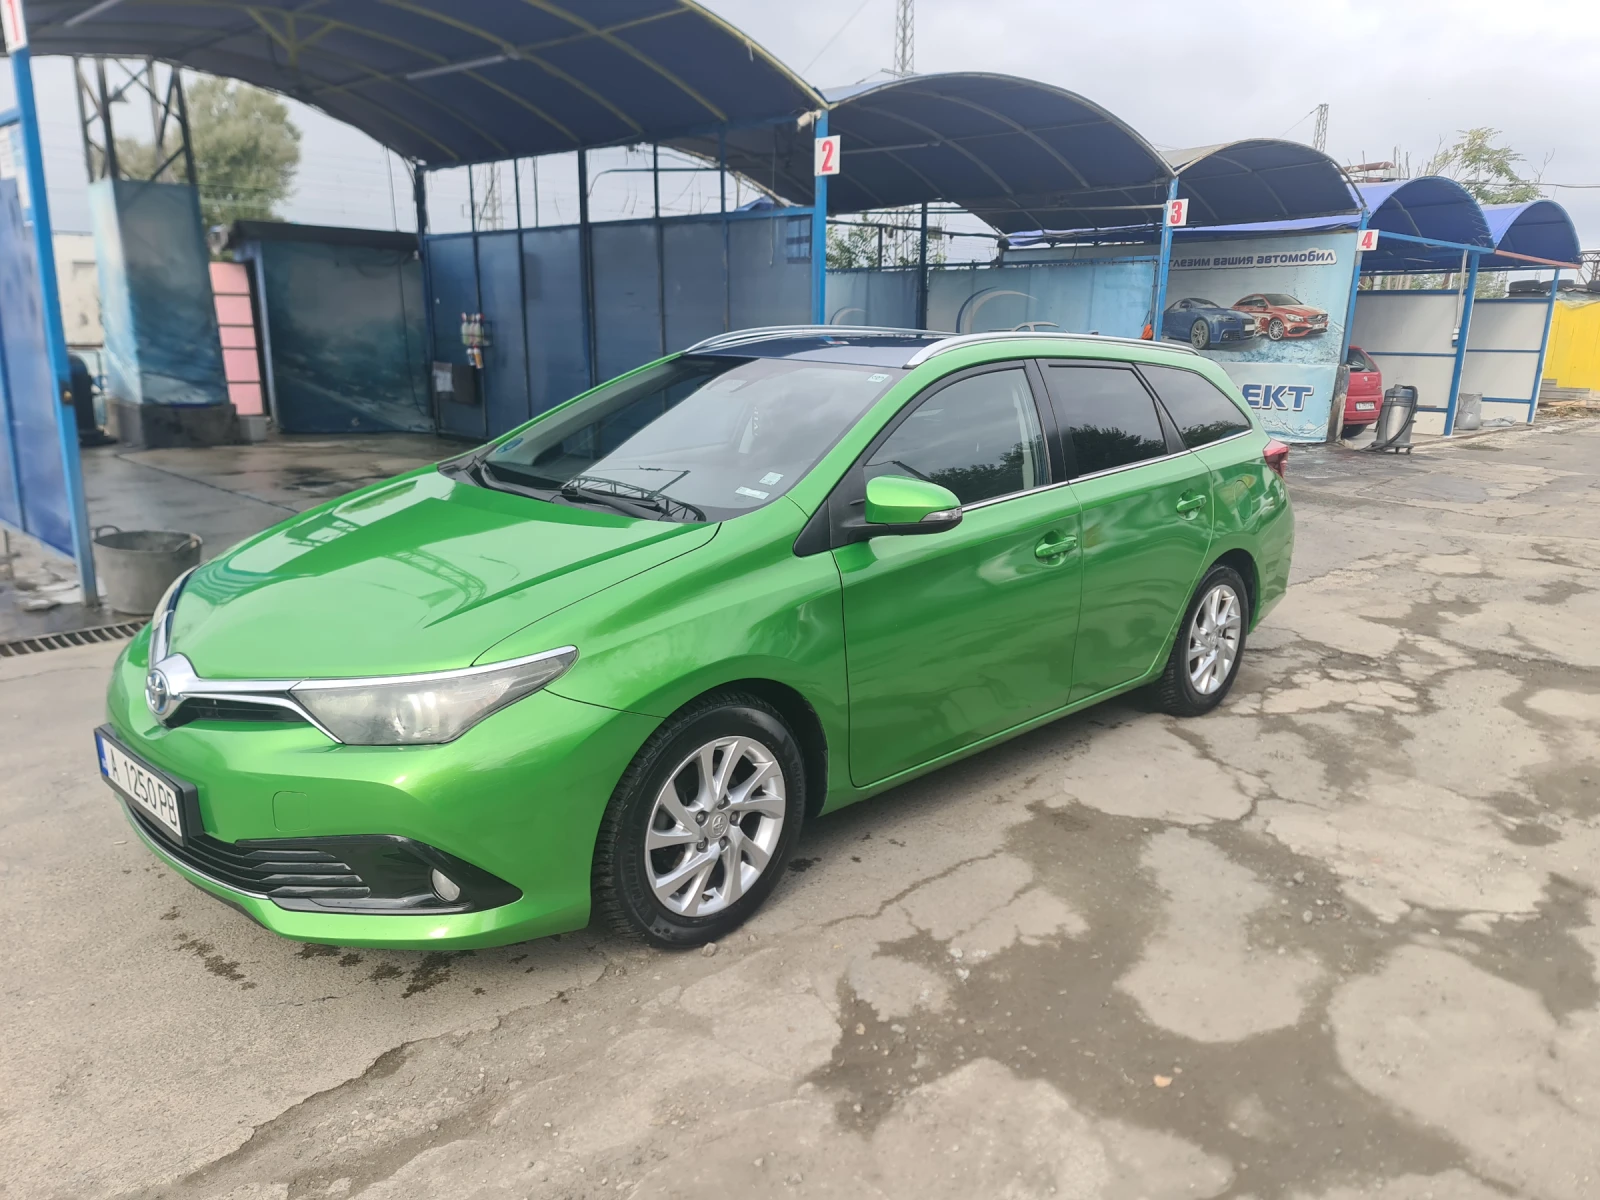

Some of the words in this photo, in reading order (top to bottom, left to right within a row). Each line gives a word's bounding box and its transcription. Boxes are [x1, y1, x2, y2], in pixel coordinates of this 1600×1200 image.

[821, 140, 834, 172] 2
[1170, 201, 1183, 224] 3
[1361, 231, 1373, 249] 4
[1213, 255, 1253, 266] вашия
[1256, 250, 1334, 264] автомобил
[123, 760, 157, 810] 1250
[157, 782, 177, 827] PB
